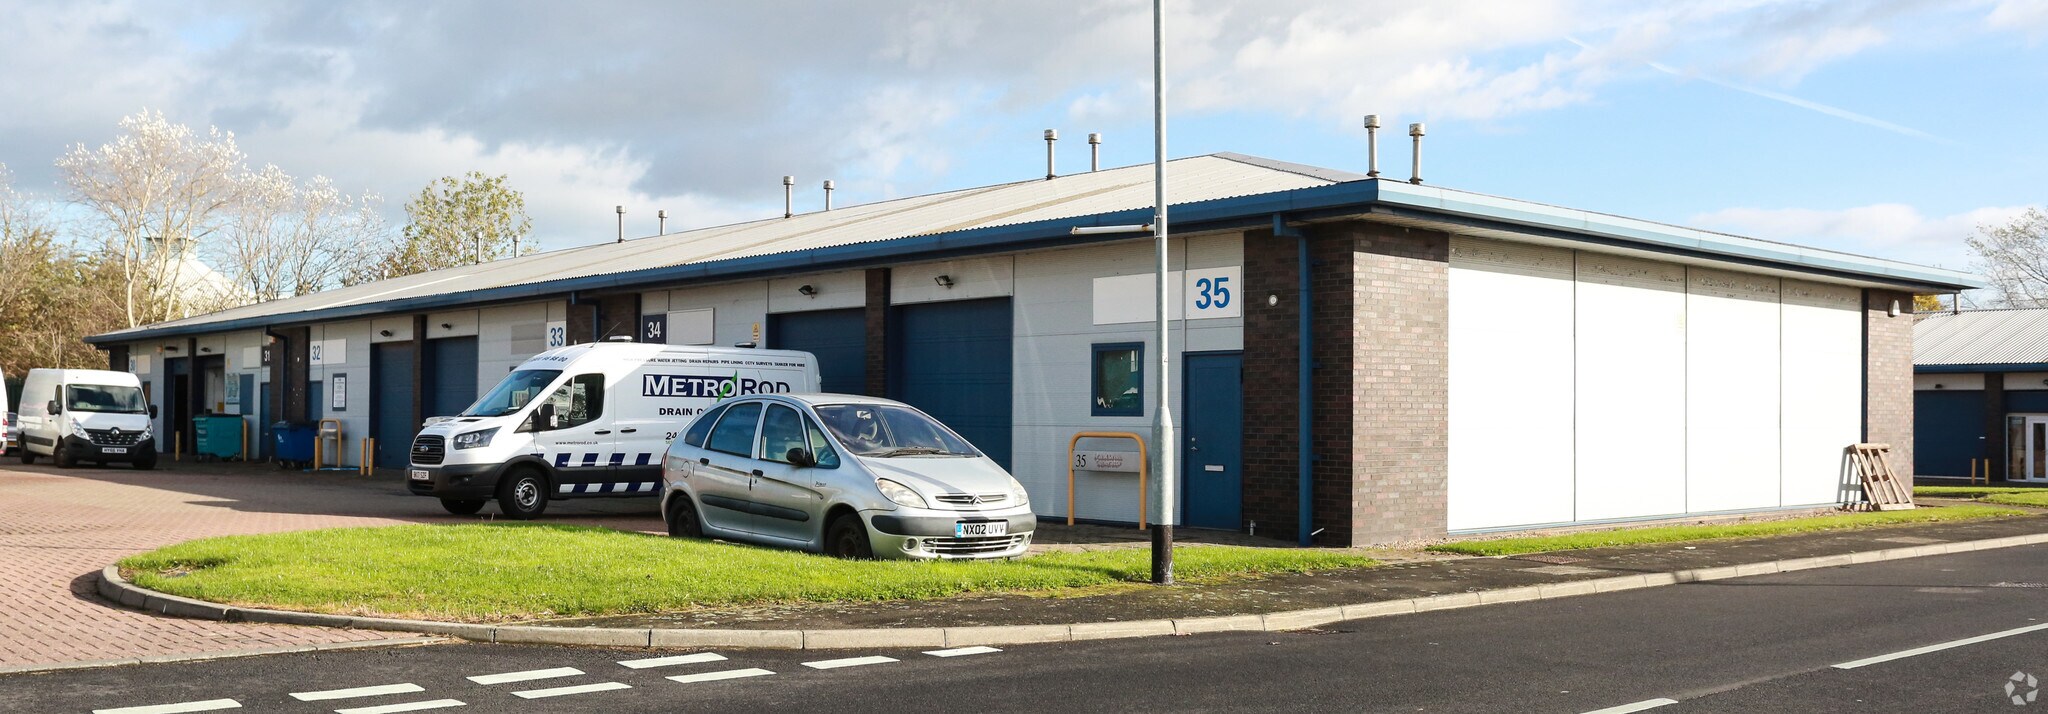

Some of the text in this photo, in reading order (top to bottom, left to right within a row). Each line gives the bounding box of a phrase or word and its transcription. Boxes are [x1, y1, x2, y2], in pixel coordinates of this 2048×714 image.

[1195, 276, 1231, 310] 35
[549, 326, 564, 347] 33
[647, 321, 661, 339] 34
[263, 350, 271, 362] 31
[312, 345, 321, 360] 32
[643, 375, 791, 398] METRO ROD
[659, 407, 693, 416] DRAIN
[1075, 454, 1087, 468] 35
[963, 524, 1004, 535] NX02 UVV
